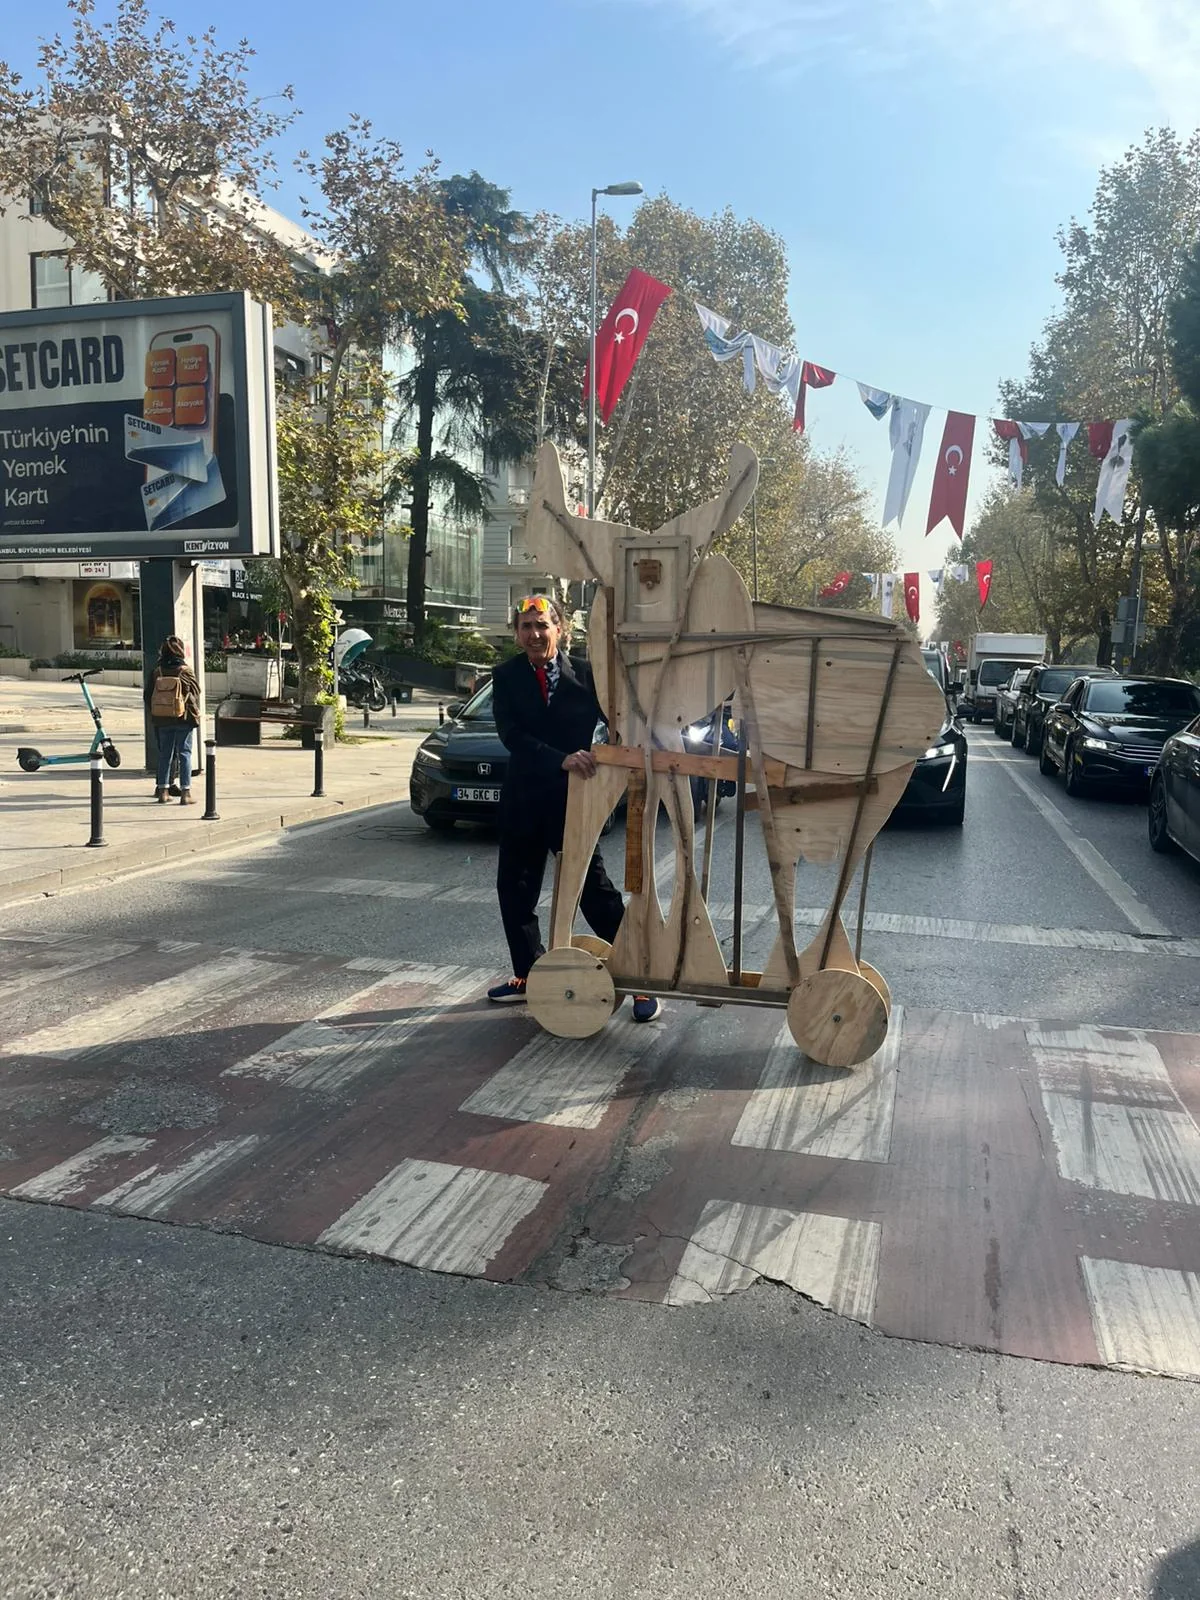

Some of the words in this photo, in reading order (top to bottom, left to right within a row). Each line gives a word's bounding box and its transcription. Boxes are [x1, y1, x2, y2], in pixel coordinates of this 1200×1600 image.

[128, 417, 161, 434] SETCARD
[2, 454, 67, 478] Yemek
[144, 473, 175, 496] SETCARD
[5, 487, 48, 507] Kartı
[232, 591, 245, 599] BLACK
[458, 789, 469, 799] 34
[473, 789, 490, 800] GKC
